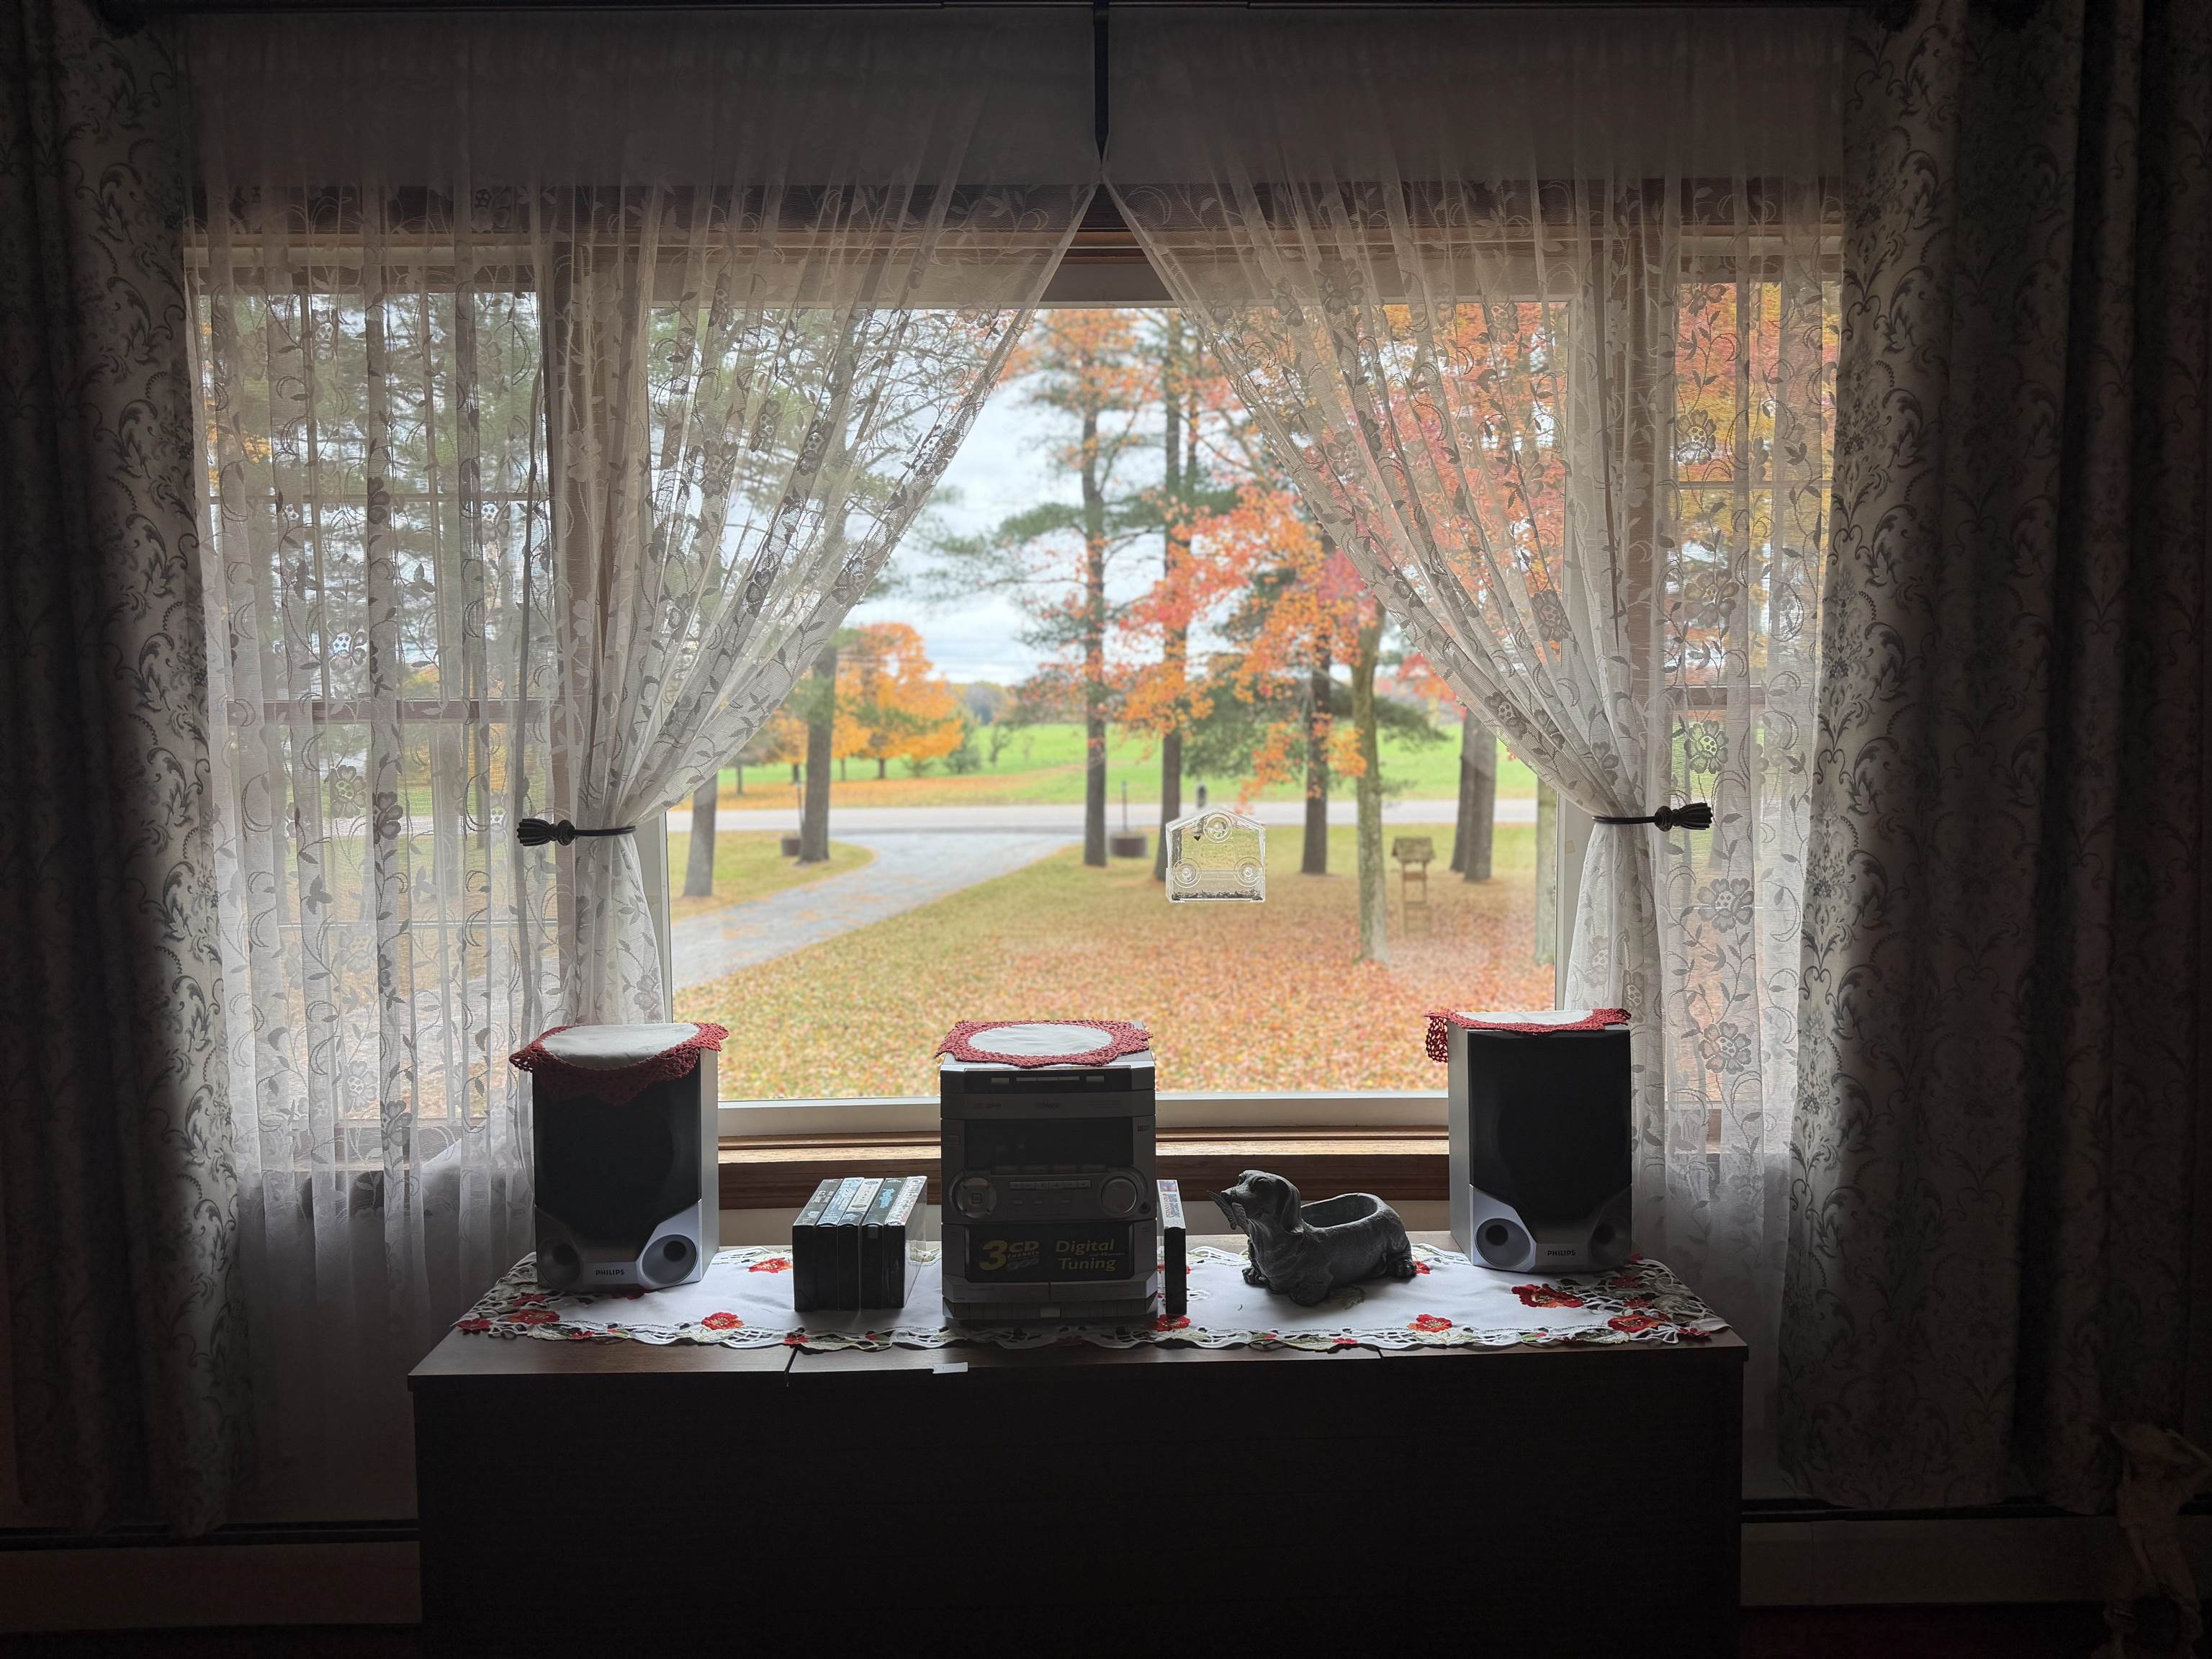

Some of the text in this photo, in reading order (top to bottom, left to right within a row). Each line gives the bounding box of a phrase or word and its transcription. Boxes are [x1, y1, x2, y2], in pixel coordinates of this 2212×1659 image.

[1056, 1238, 1115, 1255] Digital
[979, 1240, 1039, 1271] 3 CD
[1058, 1257, 1117, 1272] Tuning
